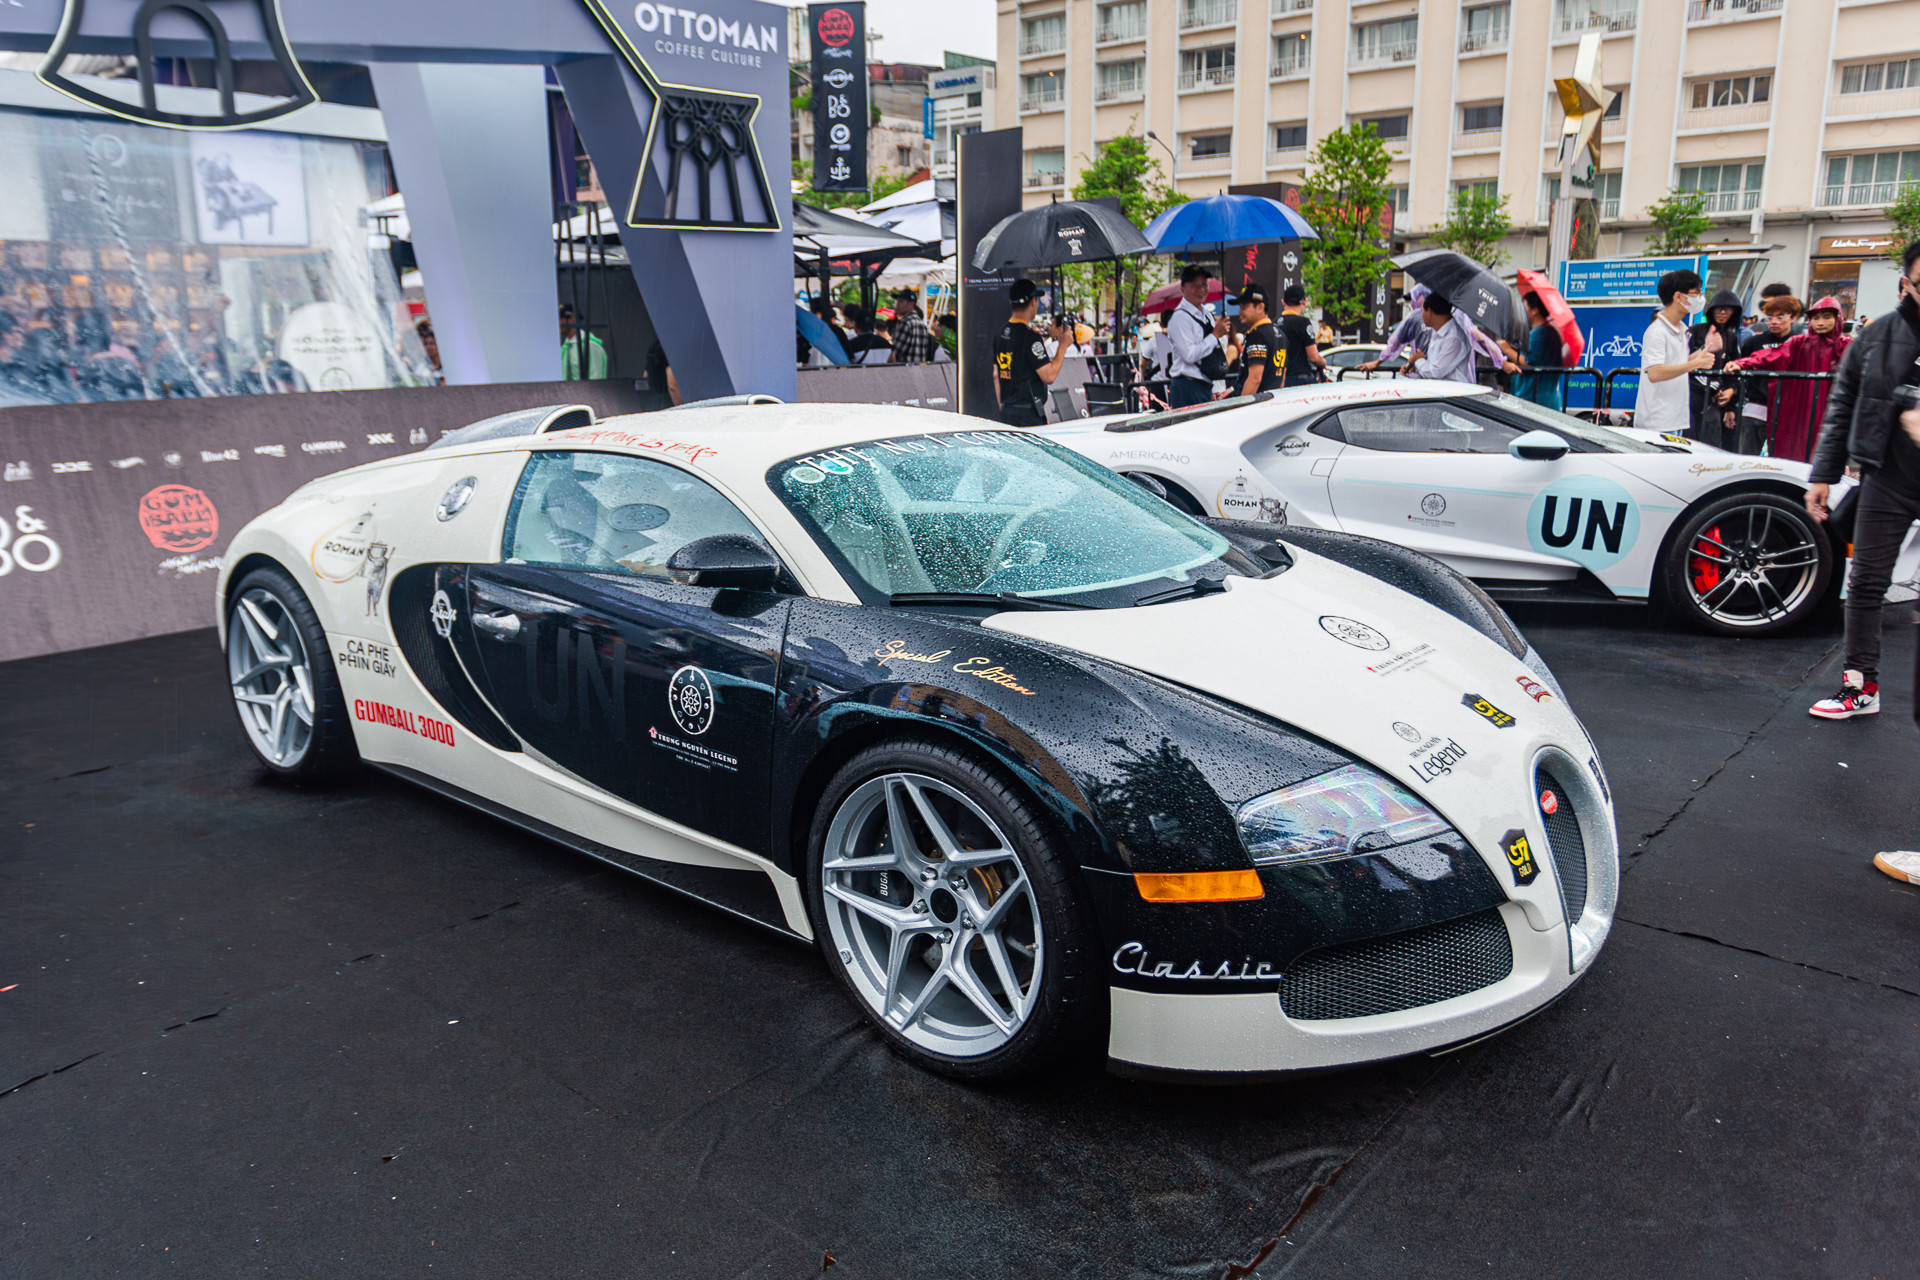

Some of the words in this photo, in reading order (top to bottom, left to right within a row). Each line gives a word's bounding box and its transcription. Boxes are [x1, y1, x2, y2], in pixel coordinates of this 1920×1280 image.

[634, 1, 778, 53] OTTOMAN
[655, 39, 705, 60] COFFEE
[711, 48, 762, 69] CULTURE
[796, 447, 876, 475] THE
[1109, 450, 1190, 465] AMERICANO
[1688, 462, 1734, 477] Special
[1739, 462, 1783, 471] Edition
[1224, 499, 1257, 507] ROMAN
[1541, 495, 1628, 553] UN
[323, 541, 365, 556] ROMAN
[874, 640, 951, 667] Special
[952, 657, 1036, 695] Edition
[354, 699, 418, 735] GUMBALL
[418, 714, 455, 747] 3000
[658, 734, 680, 746] TRUNG
[710, 750, 738, 765] LEGEND
[1409, 737, 1467, 784] Legend
[880, 869, 889, 897] BUGA
[1112, 942, 1282, 980] Classic
